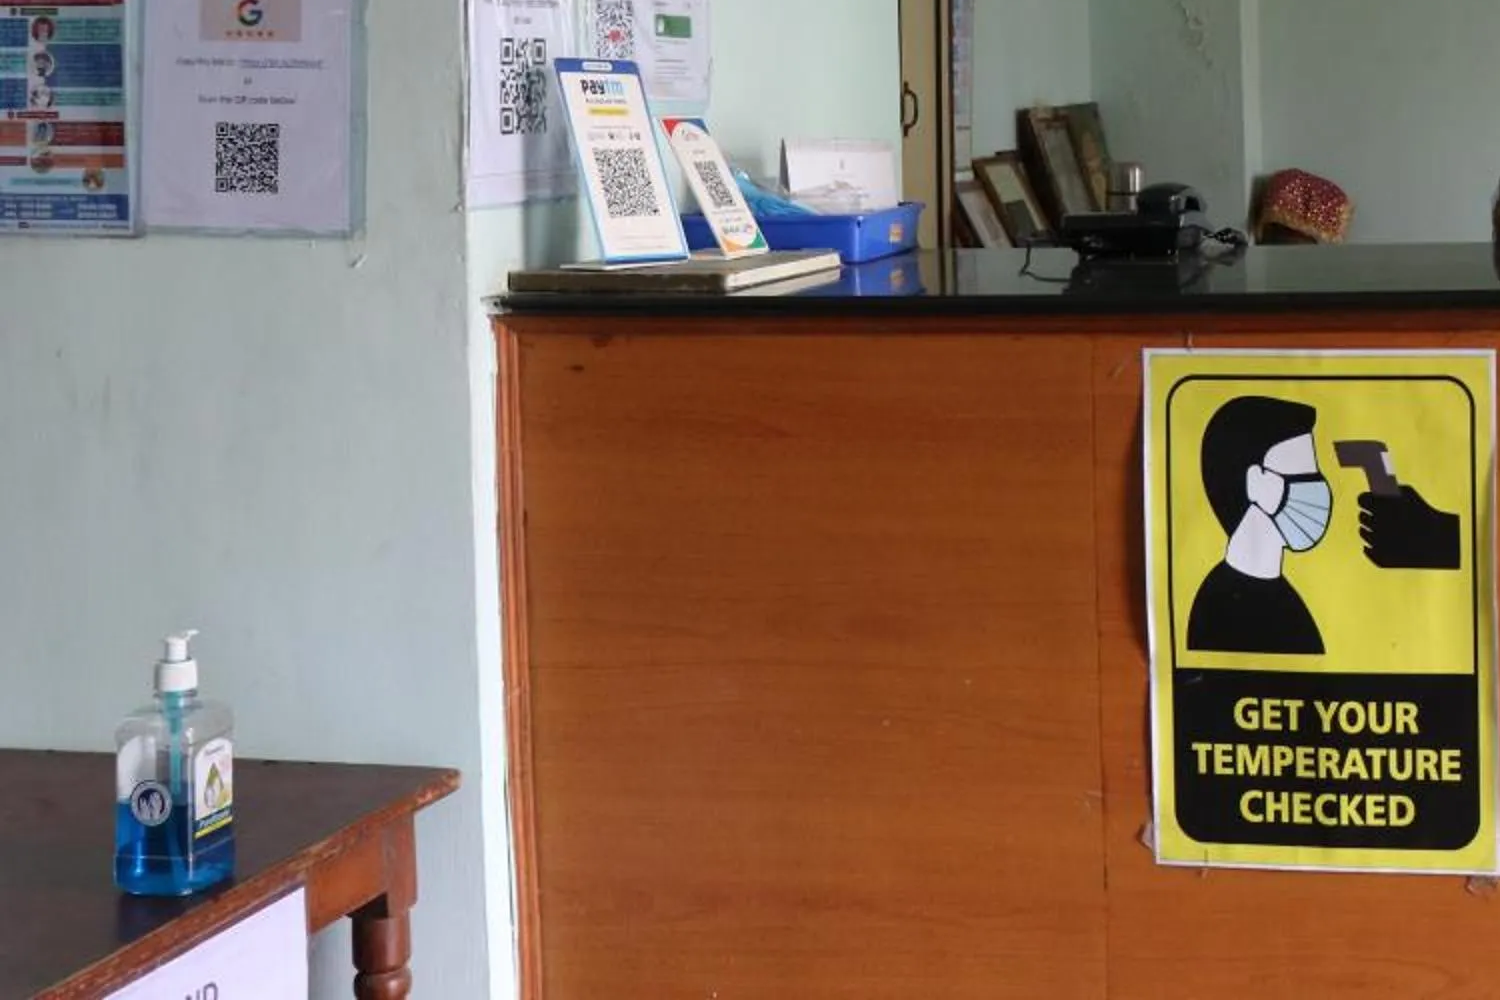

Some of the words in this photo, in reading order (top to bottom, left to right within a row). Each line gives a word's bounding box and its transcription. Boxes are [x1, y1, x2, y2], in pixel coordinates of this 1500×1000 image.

[1233, 697, 1304, 731] GET
[1314, 700, 1419, 735] YOUR
[1192, 743, 1462, 781] TEMPERATURE
[1239, 790, 1415, 827] CHECKED
